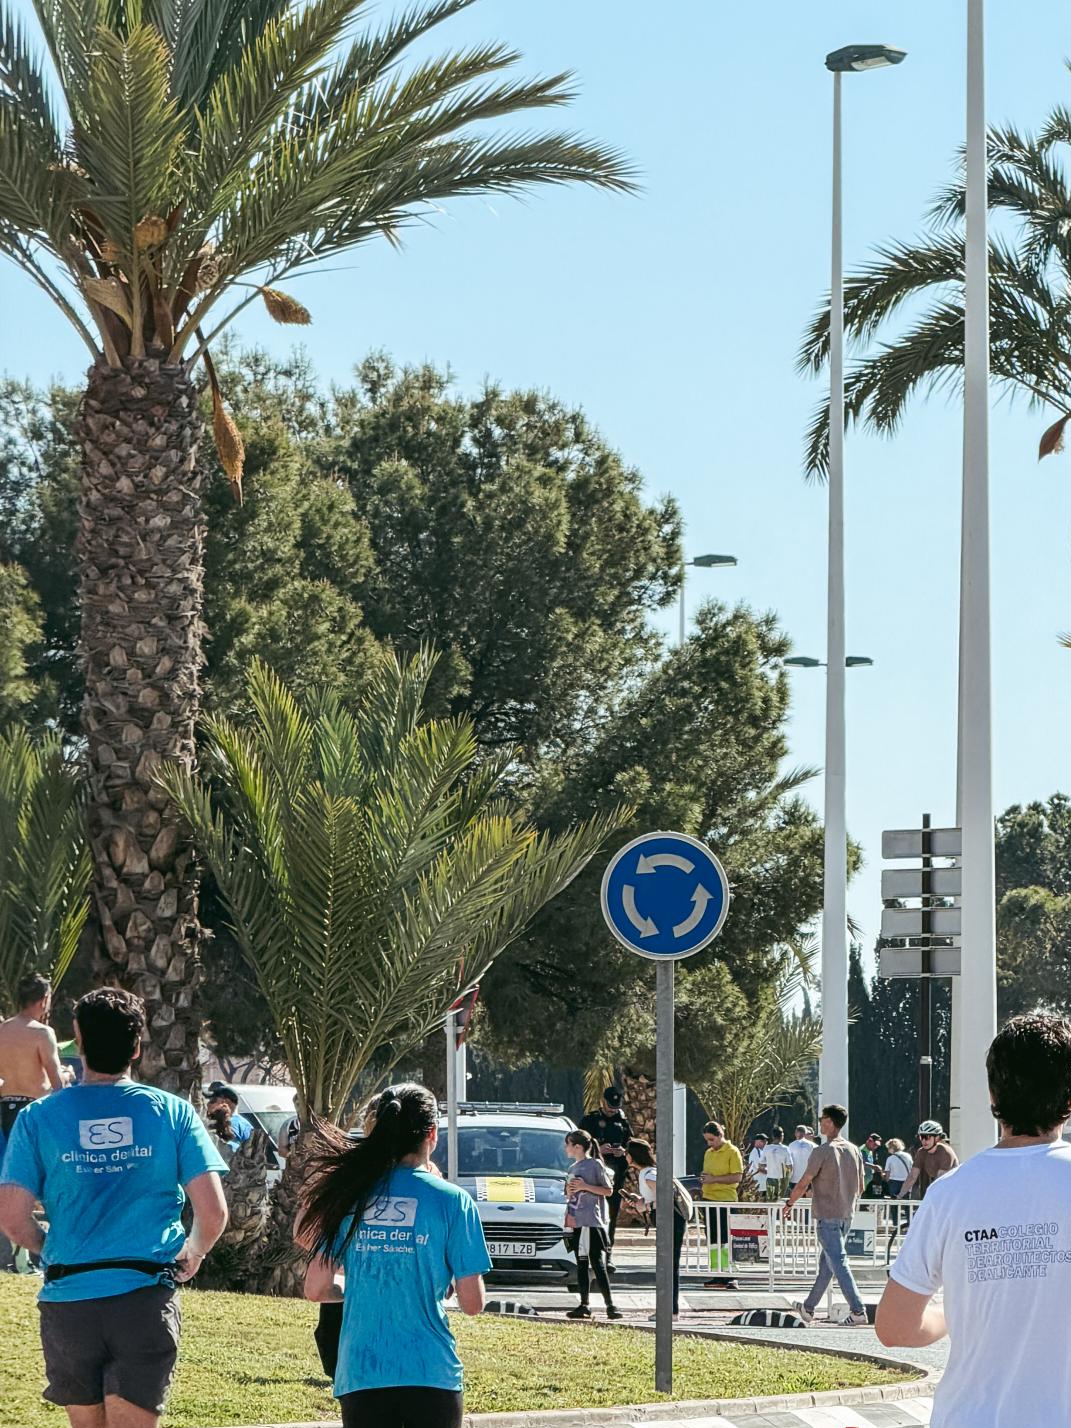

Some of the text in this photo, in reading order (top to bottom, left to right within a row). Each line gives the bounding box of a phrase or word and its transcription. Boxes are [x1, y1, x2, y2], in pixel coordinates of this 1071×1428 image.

[89, 1121, 124, 1145] ES
[486, 1243, 533, 1255] 817 LZB
